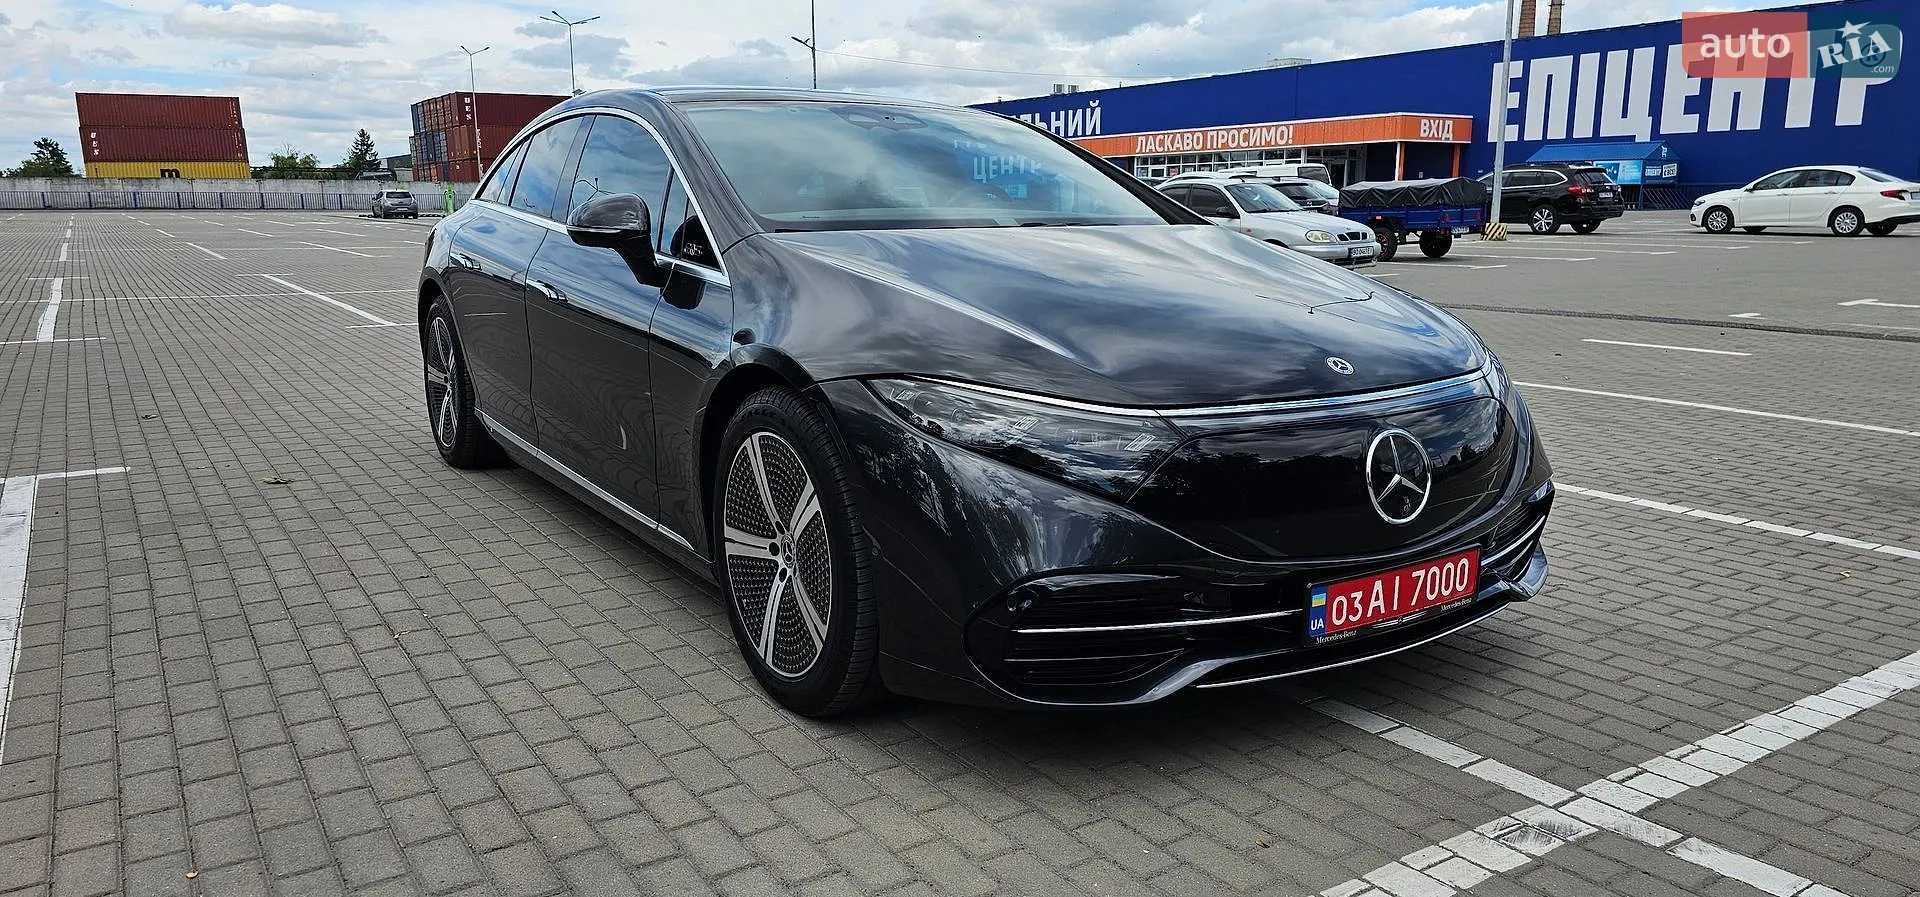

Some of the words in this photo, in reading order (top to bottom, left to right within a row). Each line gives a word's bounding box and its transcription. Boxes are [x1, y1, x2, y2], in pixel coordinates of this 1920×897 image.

[1135, 130, 1203, 153] ЛАСКАВО
[1206, 125, 1294, 149] ПРОСИМО!
[1420, 119, 1453, 141] ВХІД
[1410, 558, 1469, 606] 7000
[1440, 597, 1472, 612] Mercedes-Benz
[1310, 617, 1325, 630] UA
[1315, 630, 1357, 645] Mercedes-Benz
